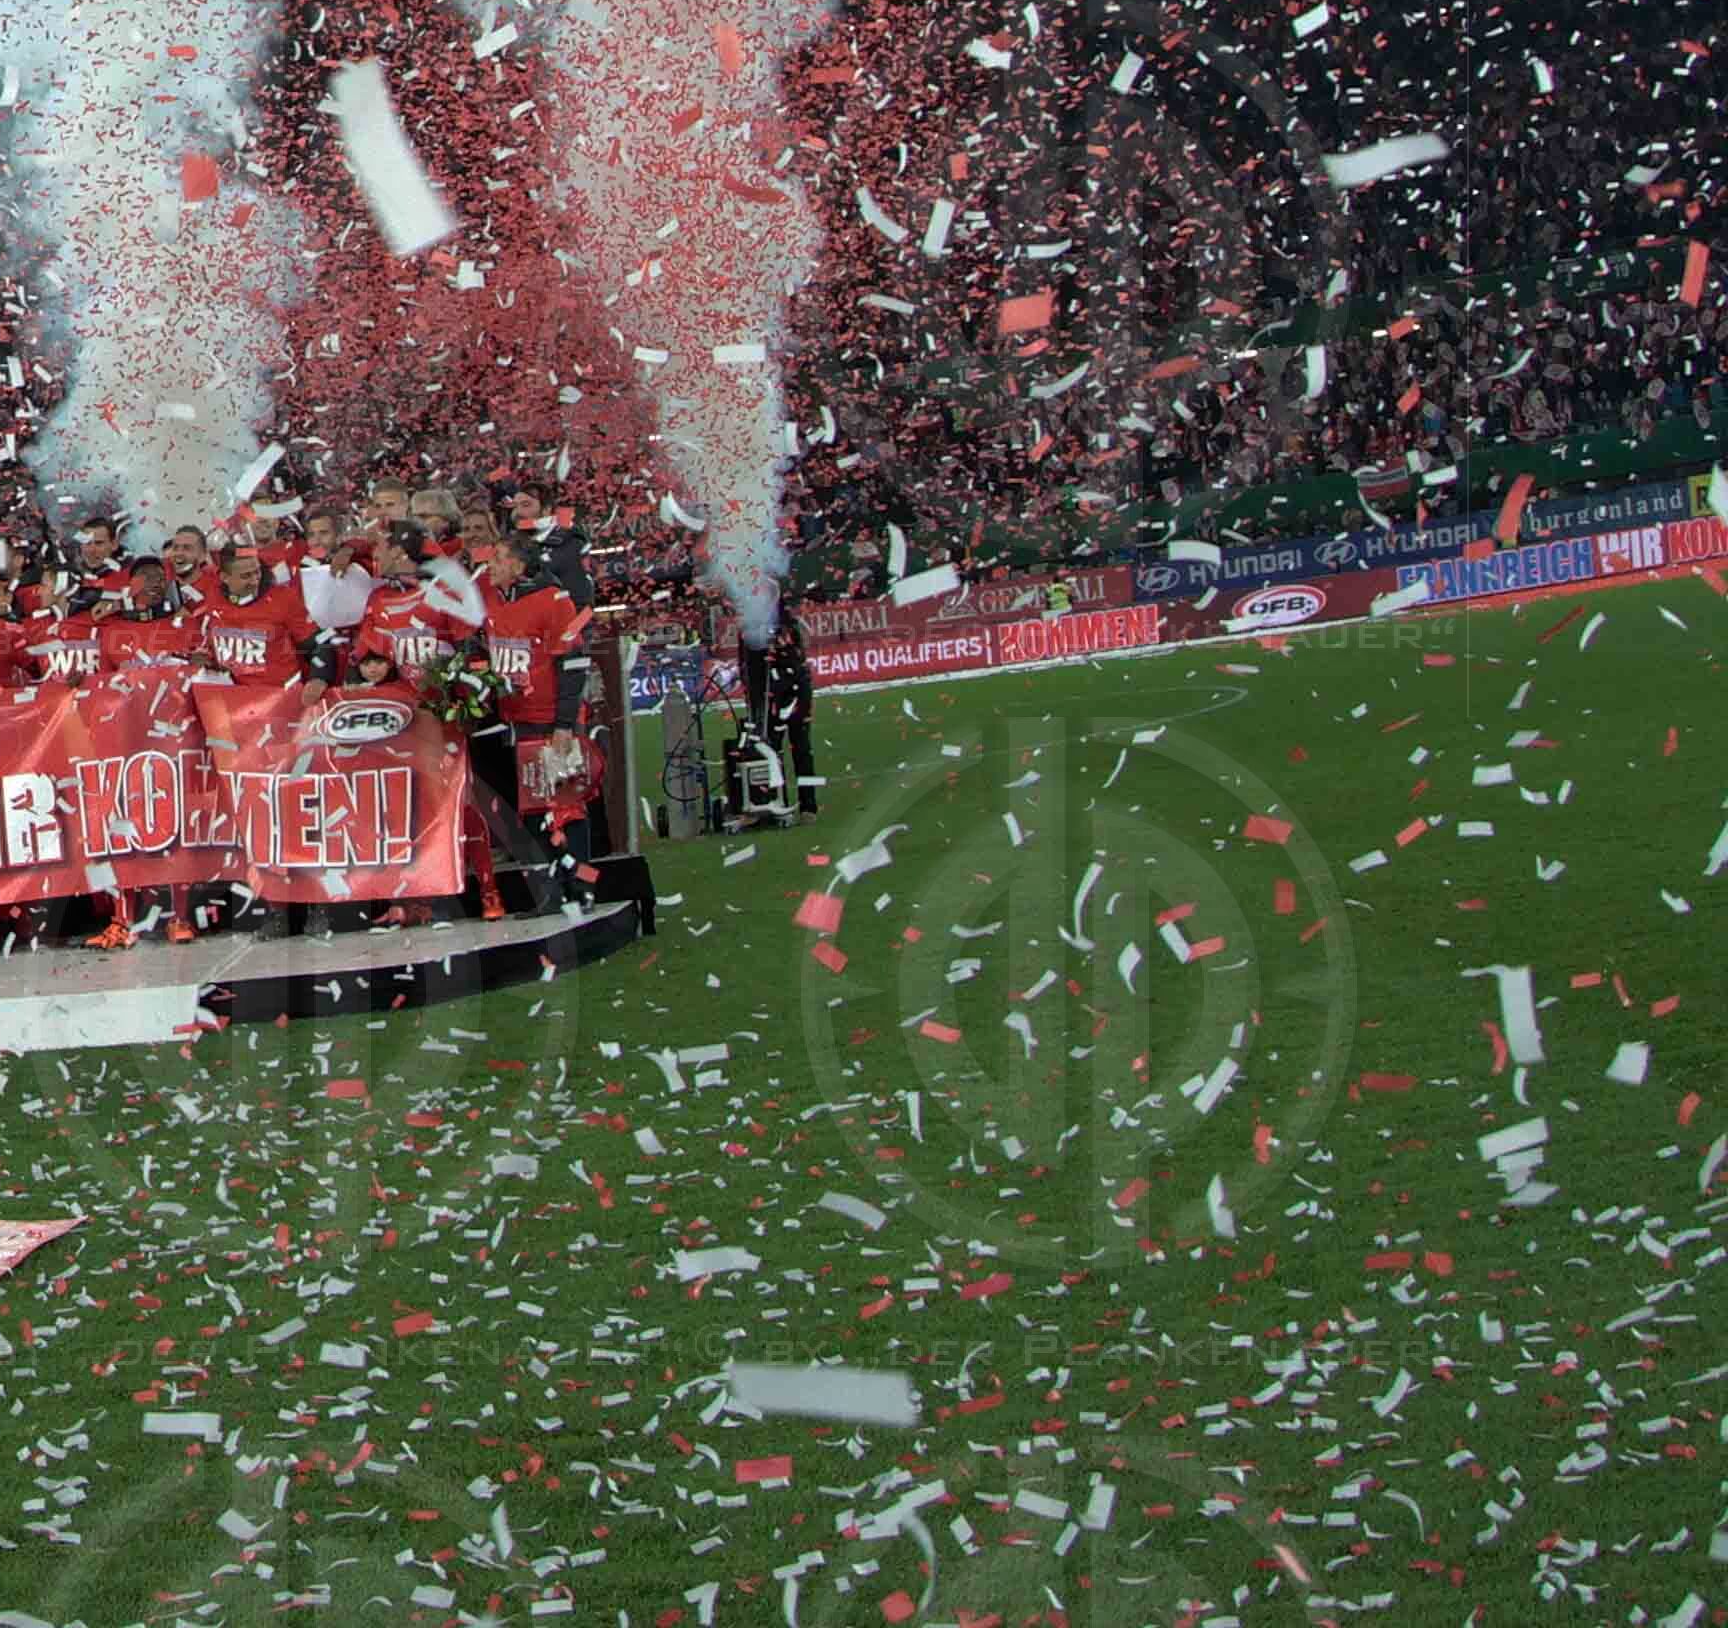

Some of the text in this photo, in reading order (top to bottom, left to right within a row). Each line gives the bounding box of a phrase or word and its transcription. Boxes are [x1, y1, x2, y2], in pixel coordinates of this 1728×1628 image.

[1189, 549, 1302, 586] HYUNDAI
[213, 634, 266, 665] WIR
[864, 634, 984, 671] QUALIFIERS
